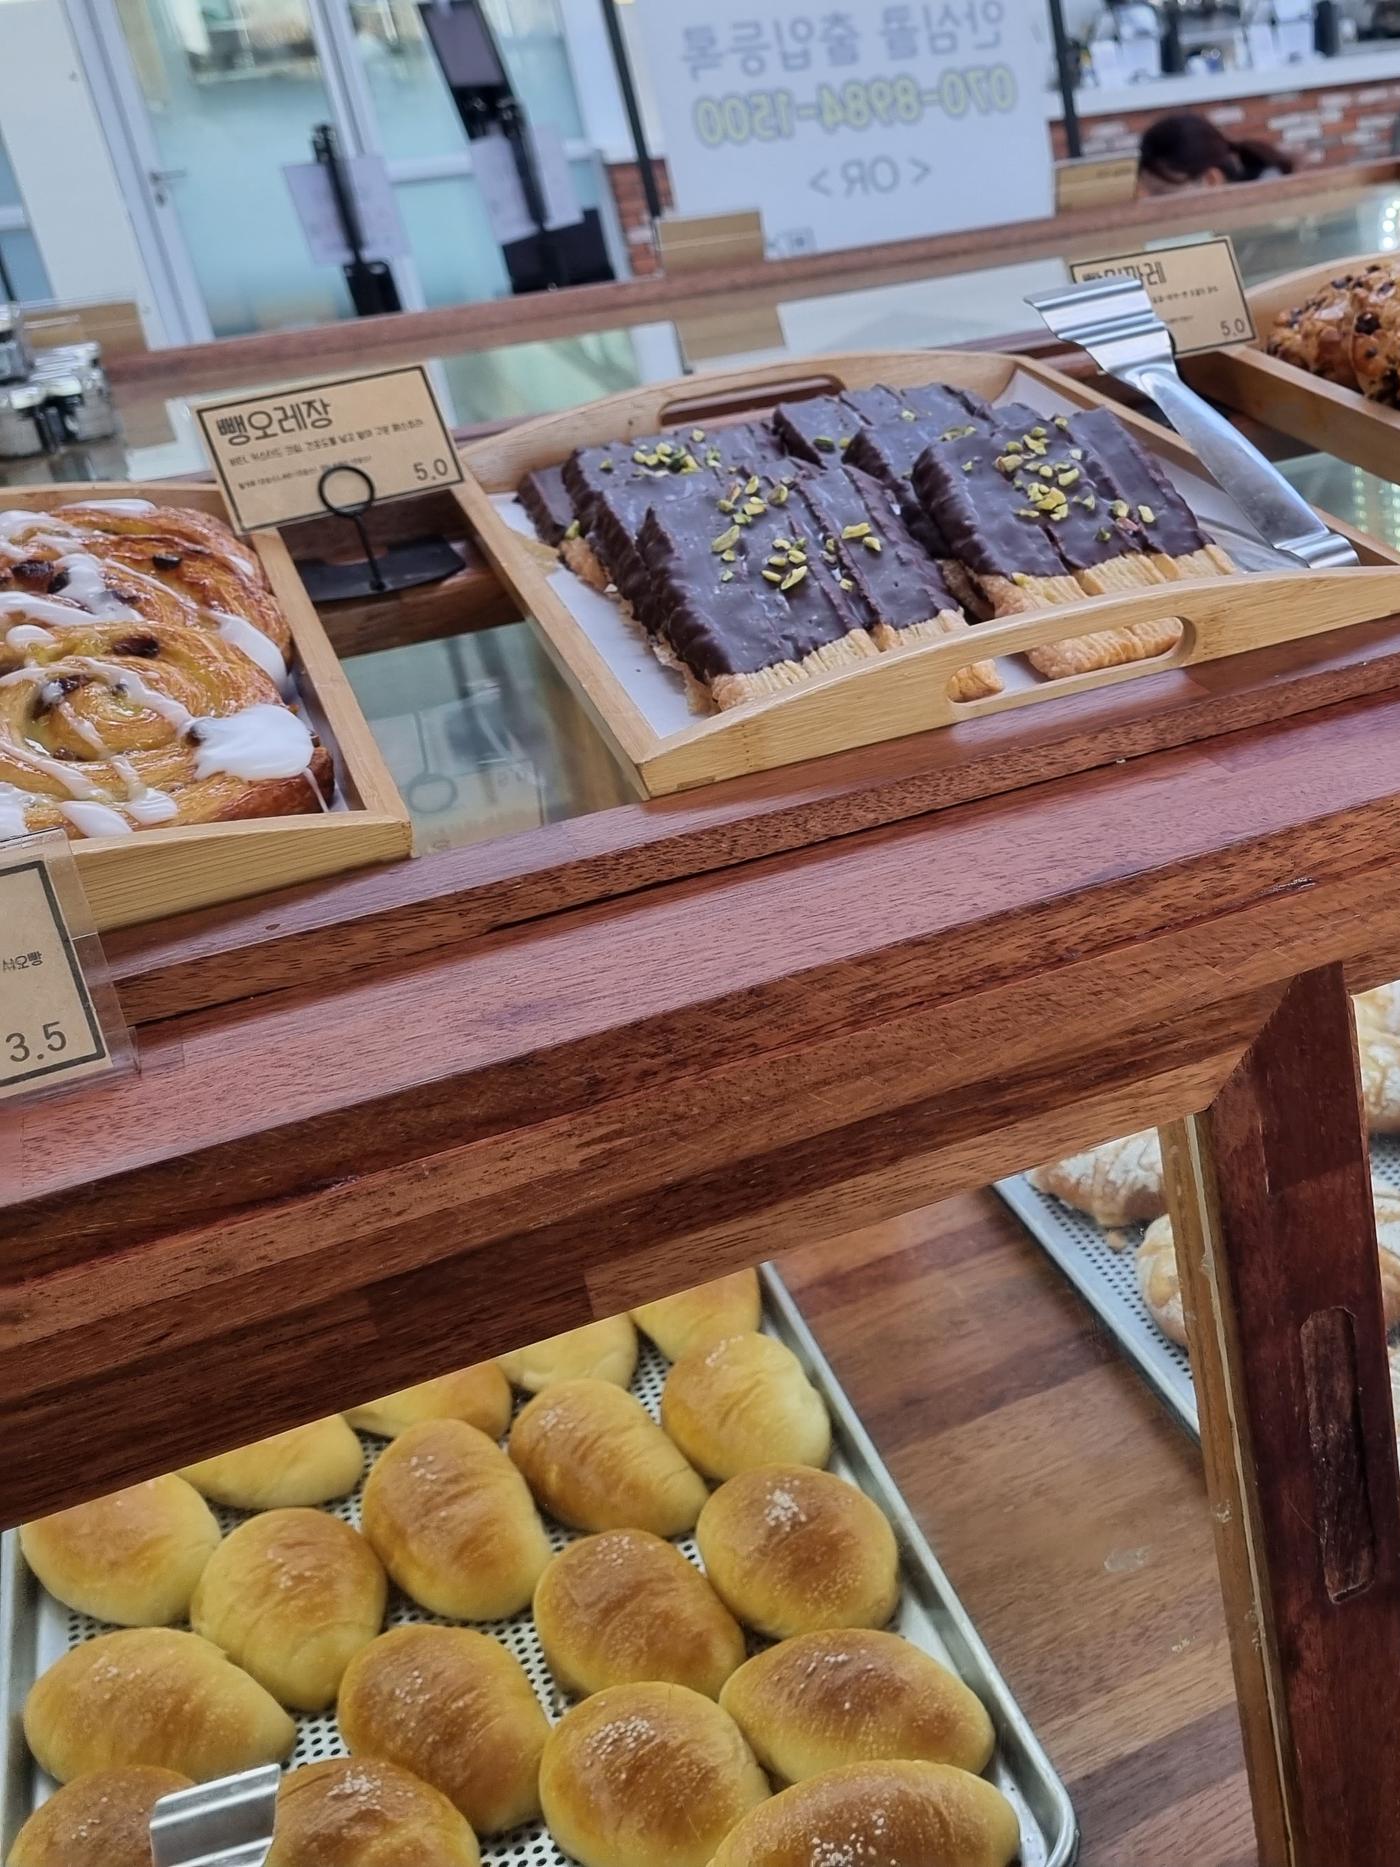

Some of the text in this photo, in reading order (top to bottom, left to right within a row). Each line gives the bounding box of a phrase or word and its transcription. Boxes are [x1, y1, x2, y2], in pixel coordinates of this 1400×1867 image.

[1220, 317, 1246, 337] 5.0
[216, 398, 333, 446] 뺑오레장
[413, 458, 448, 481] 5.0
[5, 1021, 67, 1063] 3.5
